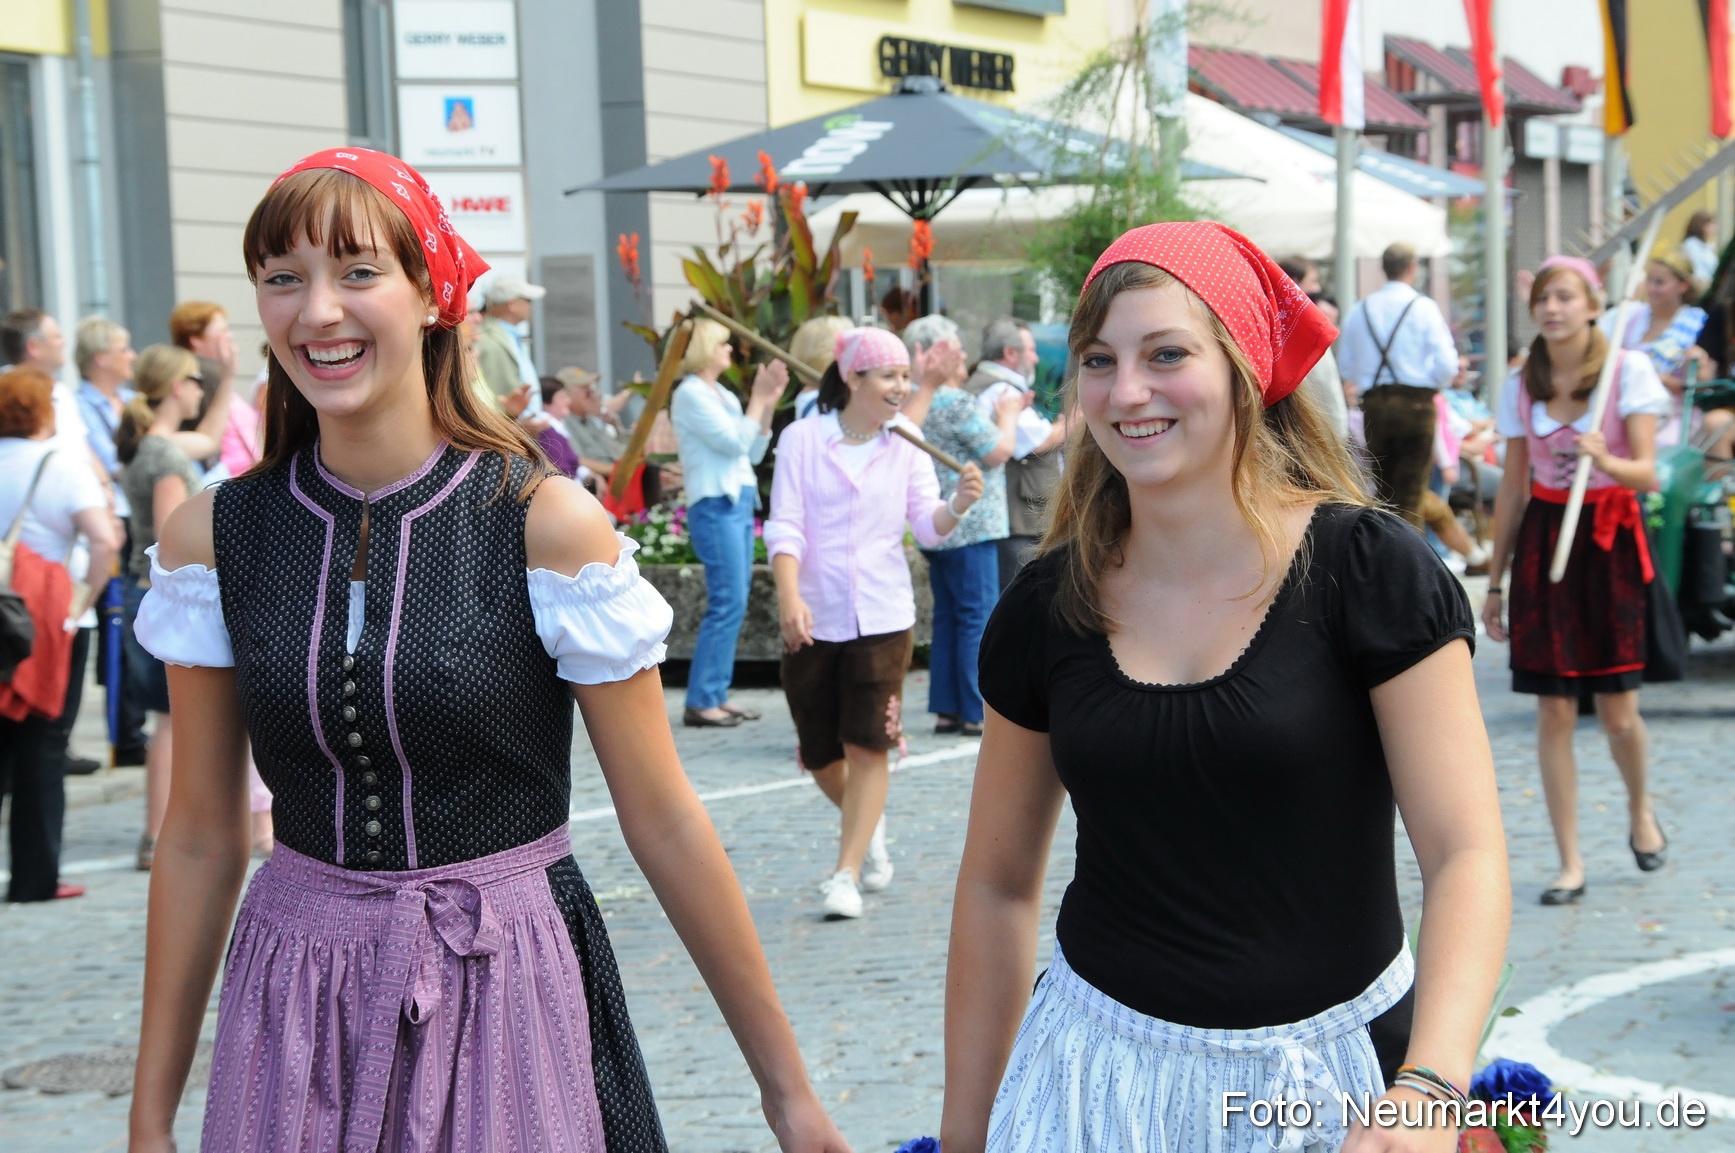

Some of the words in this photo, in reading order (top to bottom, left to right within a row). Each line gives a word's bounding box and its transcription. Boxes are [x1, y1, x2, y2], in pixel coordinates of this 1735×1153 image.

[404, 32, 451, 46] GERRY
[457, 33, 507, 46] WEBER
[879, 36, 946, 78] GERRY
[950, 46, 1014, 92] WEBER
